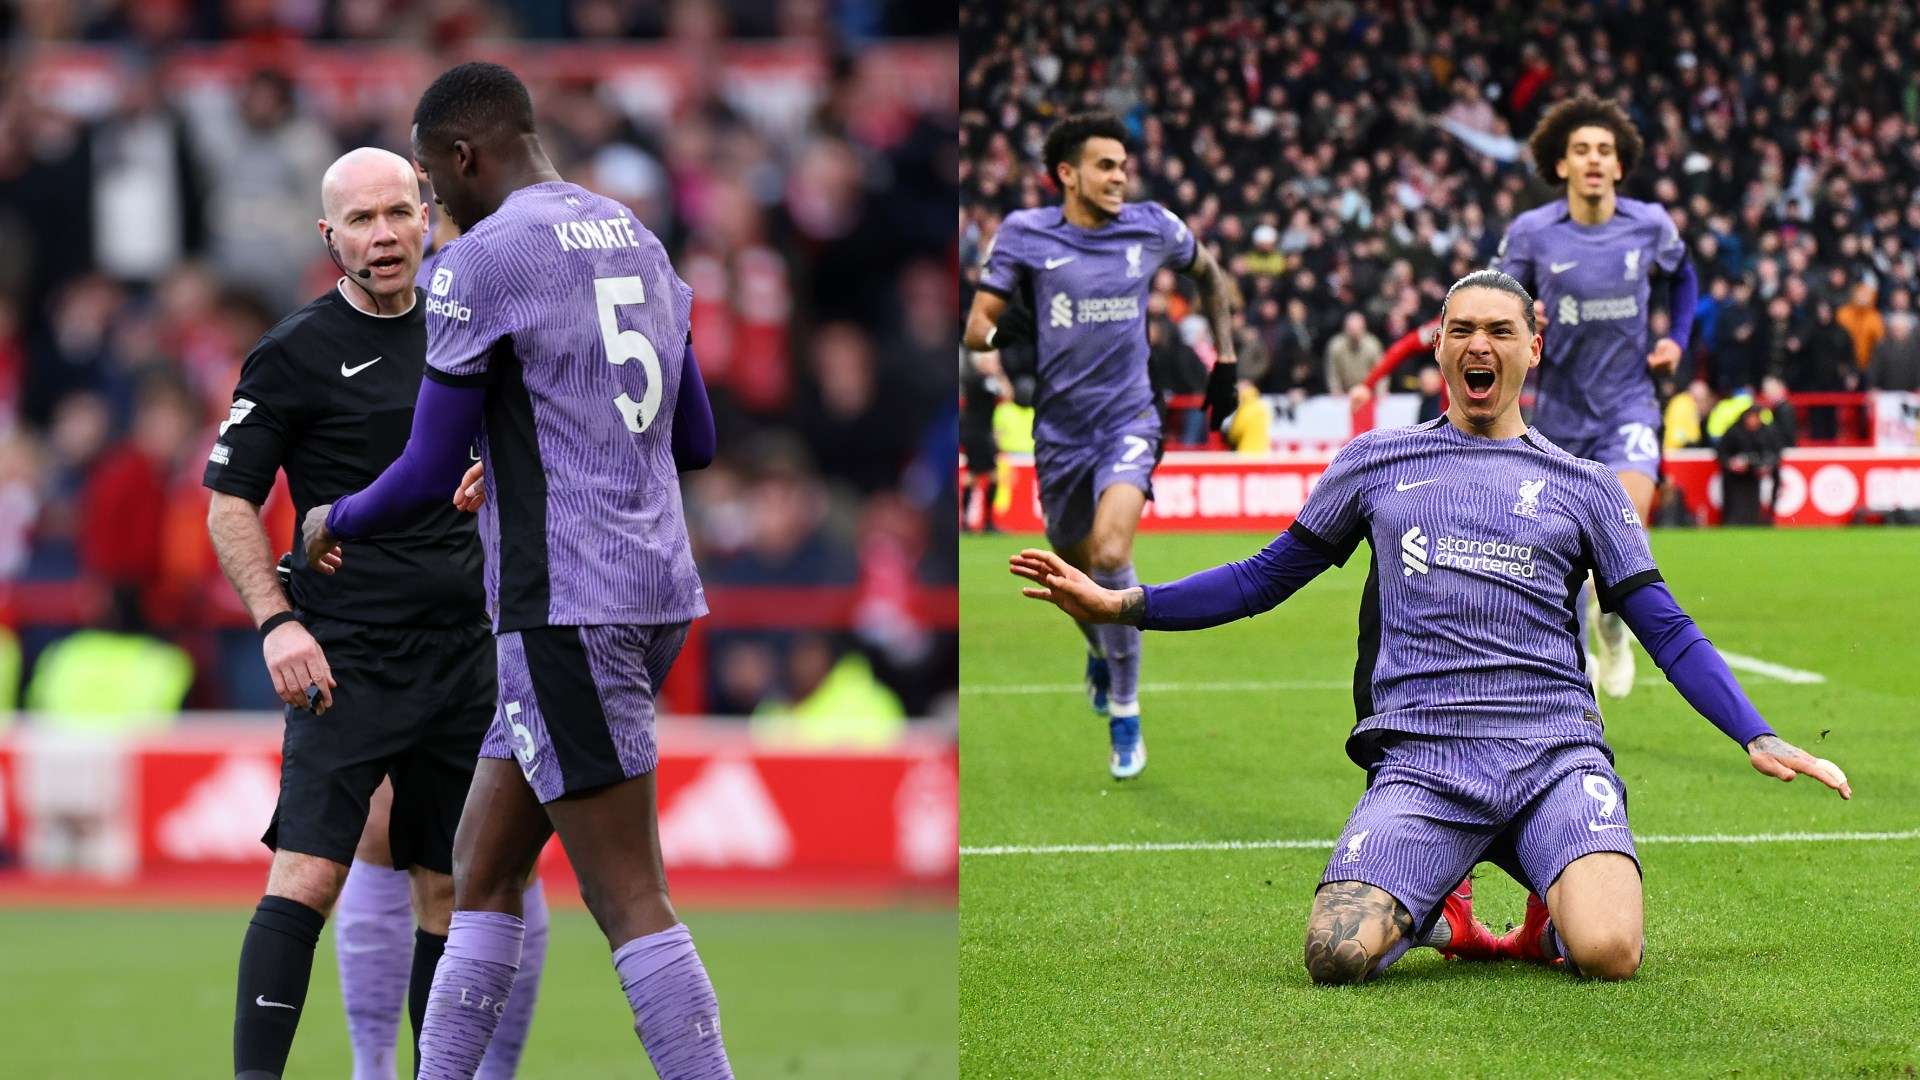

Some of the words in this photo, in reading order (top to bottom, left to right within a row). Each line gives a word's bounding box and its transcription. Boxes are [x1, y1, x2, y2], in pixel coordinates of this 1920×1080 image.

[553, 209, 640, 251] KONATÉ
[593, 276, 663, 433] 5
[1122, 435, 1148, 463] 7
[1618, 422, 1659, 459] 76
[1435, 550, 1535, 578] chartered
[1437, 535, 1533, 562] standard
[505, 700, 535, 763] 5
[1582, 774, 1618, 818] 9
